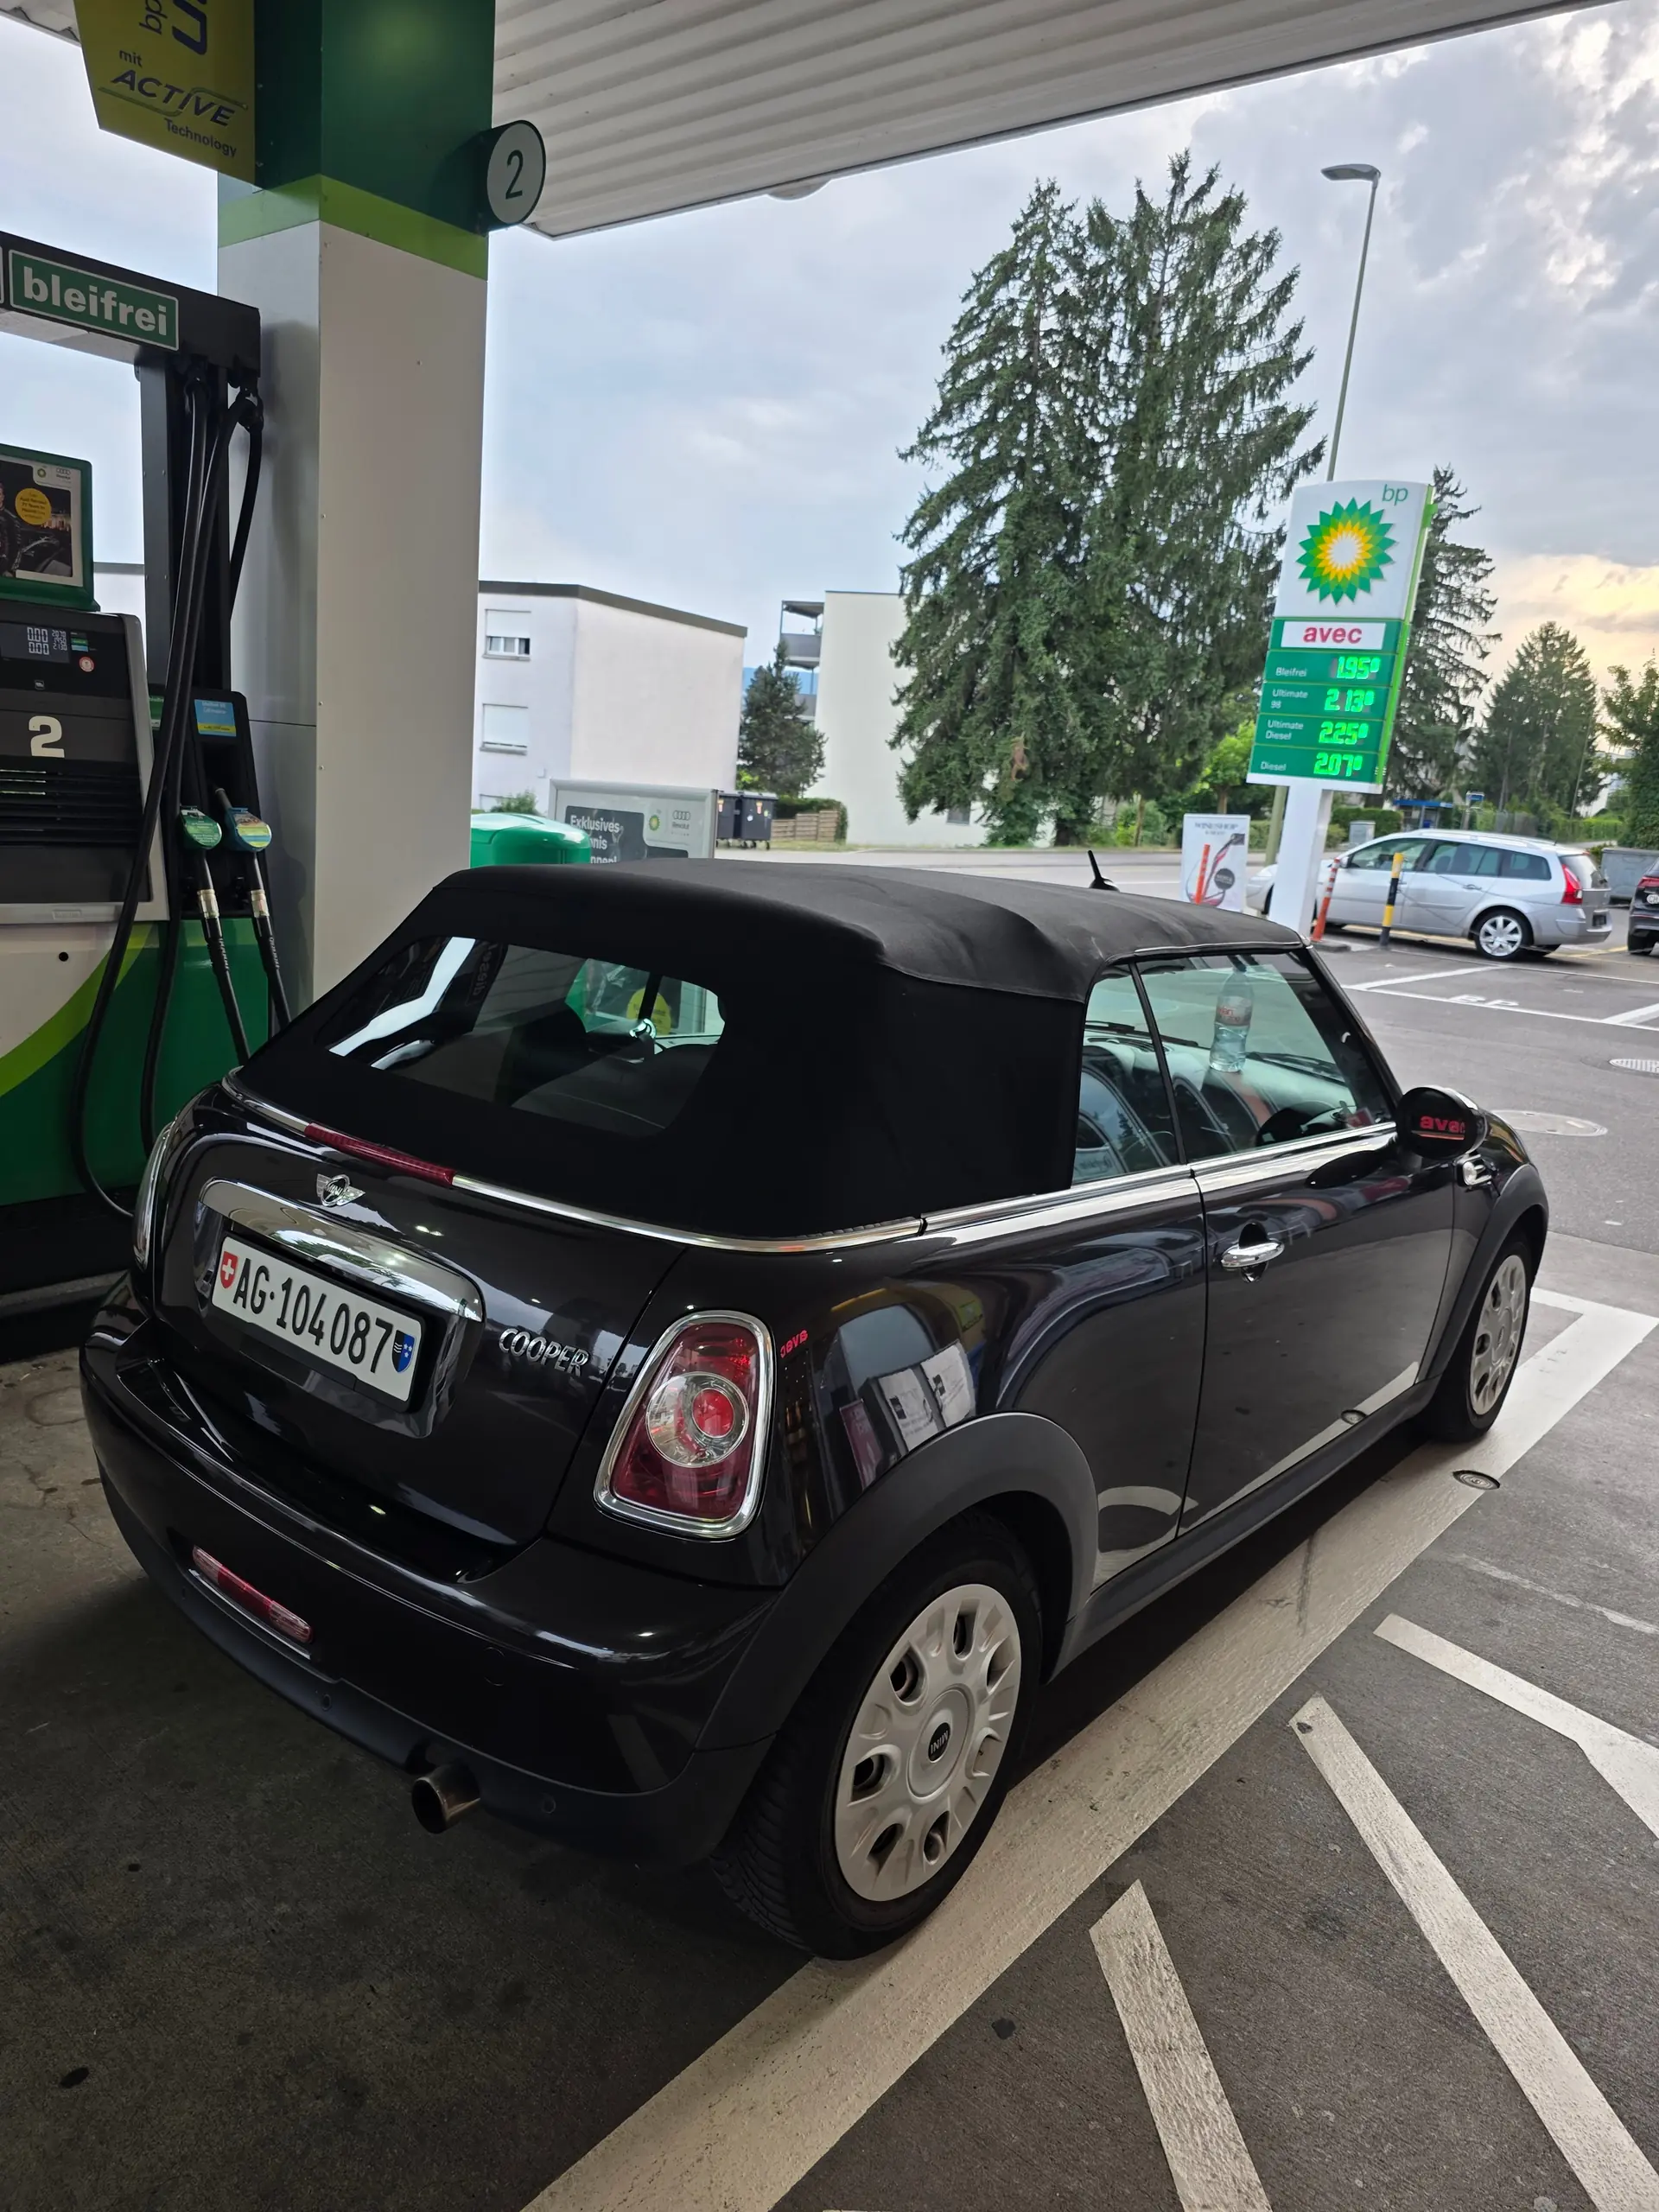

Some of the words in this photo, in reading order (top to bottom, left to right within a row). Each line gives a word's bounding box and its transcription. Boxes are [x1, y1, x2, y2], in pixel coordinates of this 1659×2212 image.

[119, 50, 143, 67] mit
[111, 69, 235, 127] ACTIVE
[164, 118, 237, 157] Technology
[505, 149, 524, 200] 2
[23, 266, 167, 336] bleifrei
[1382, 484, 1408, 506] bp
[1303, 627, 1363, 644] avec
[1275, 667, 1306, 677] Bleifrei
[1272, 689, 1308, 699] Ultimate
[1267, 720, 1304, 729] Ultimate
[28, 715, 65, 758] 2
[1265, 730, 1292, 741] Diesel
[1260, 761, 1287, 771] Diesel
[570, 815, 620, 833] Exklusives
[499, 1328, 589, 1377] COOPER
[930, 1730, 949, 1755] MINI
